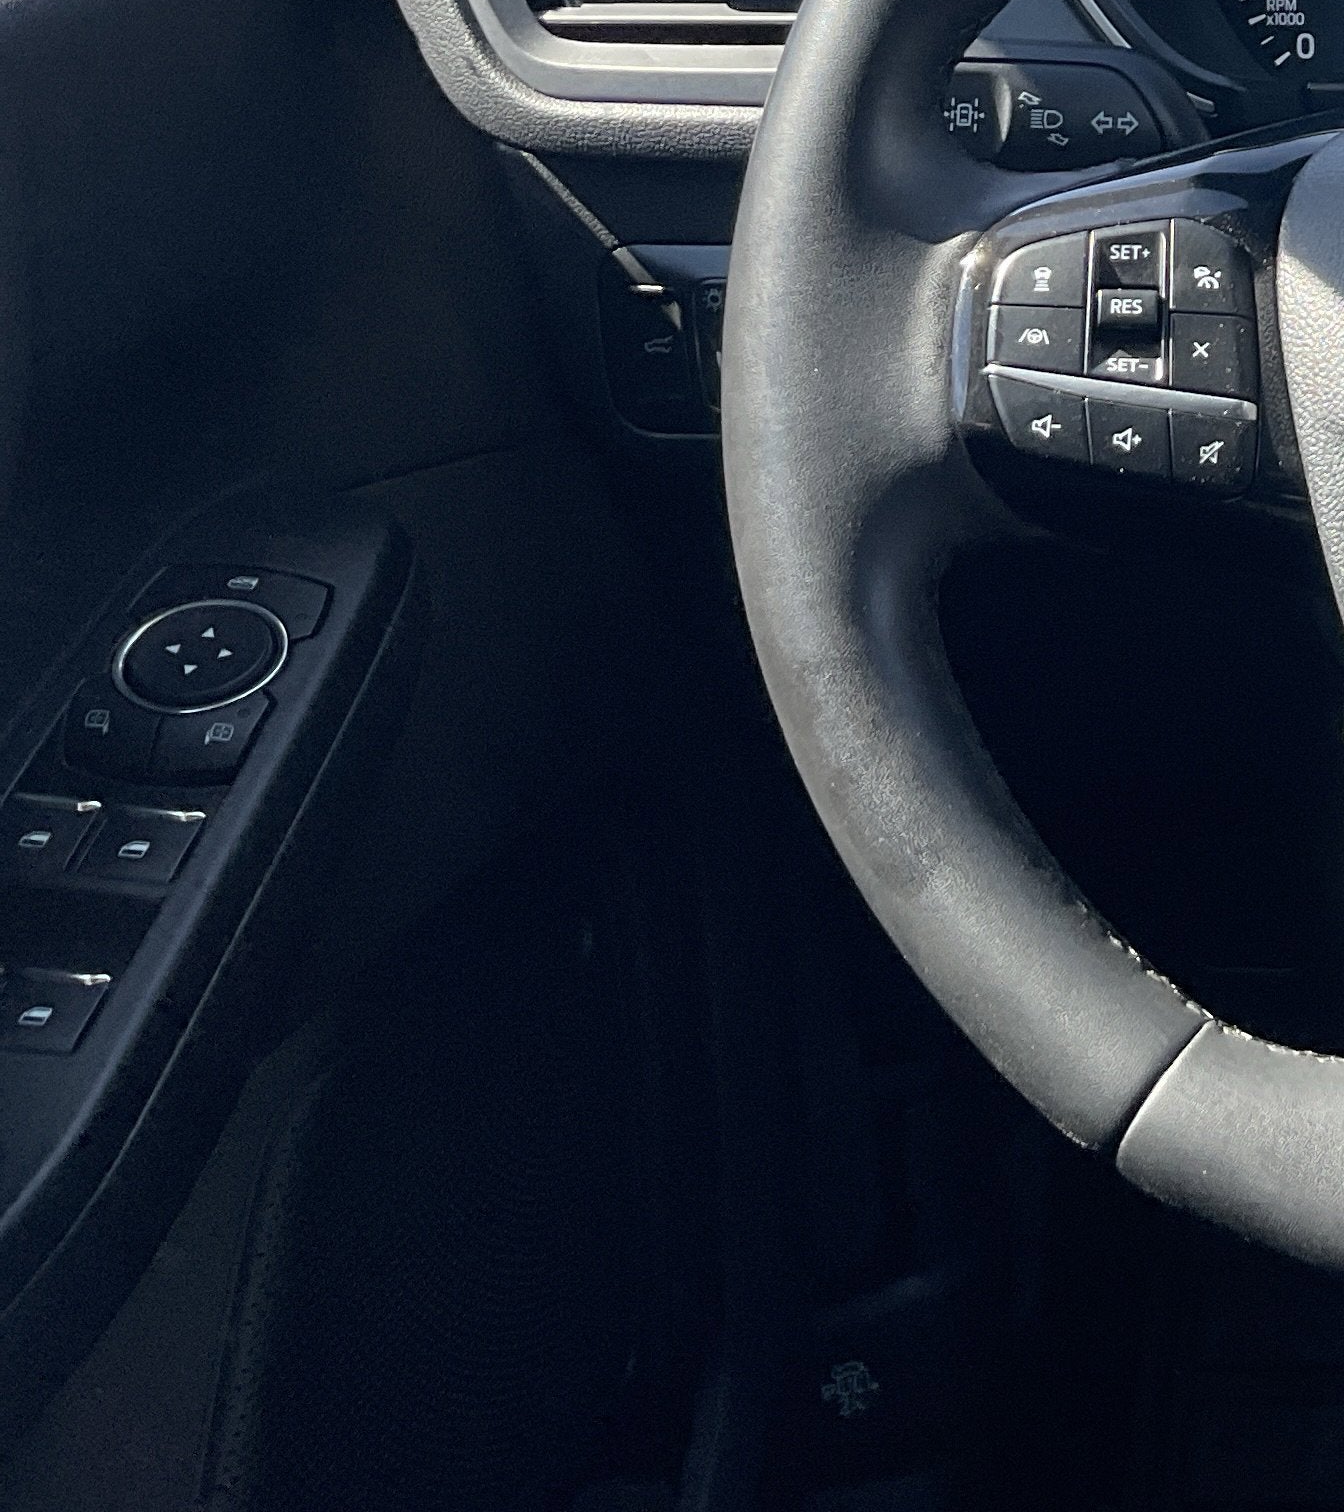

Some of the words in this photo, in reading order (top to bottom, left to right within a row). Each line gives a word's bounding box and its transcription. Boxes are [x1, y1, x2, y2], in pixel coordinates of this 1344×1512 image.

[1266, 12, 1305, 26] x1000
[1296, 33, 1315, 59] 0
[1110, 245, 1150, 259] SET+
[1110, 299, 1142, 314] RES
[1107, 358, 1148, 371] SET-
